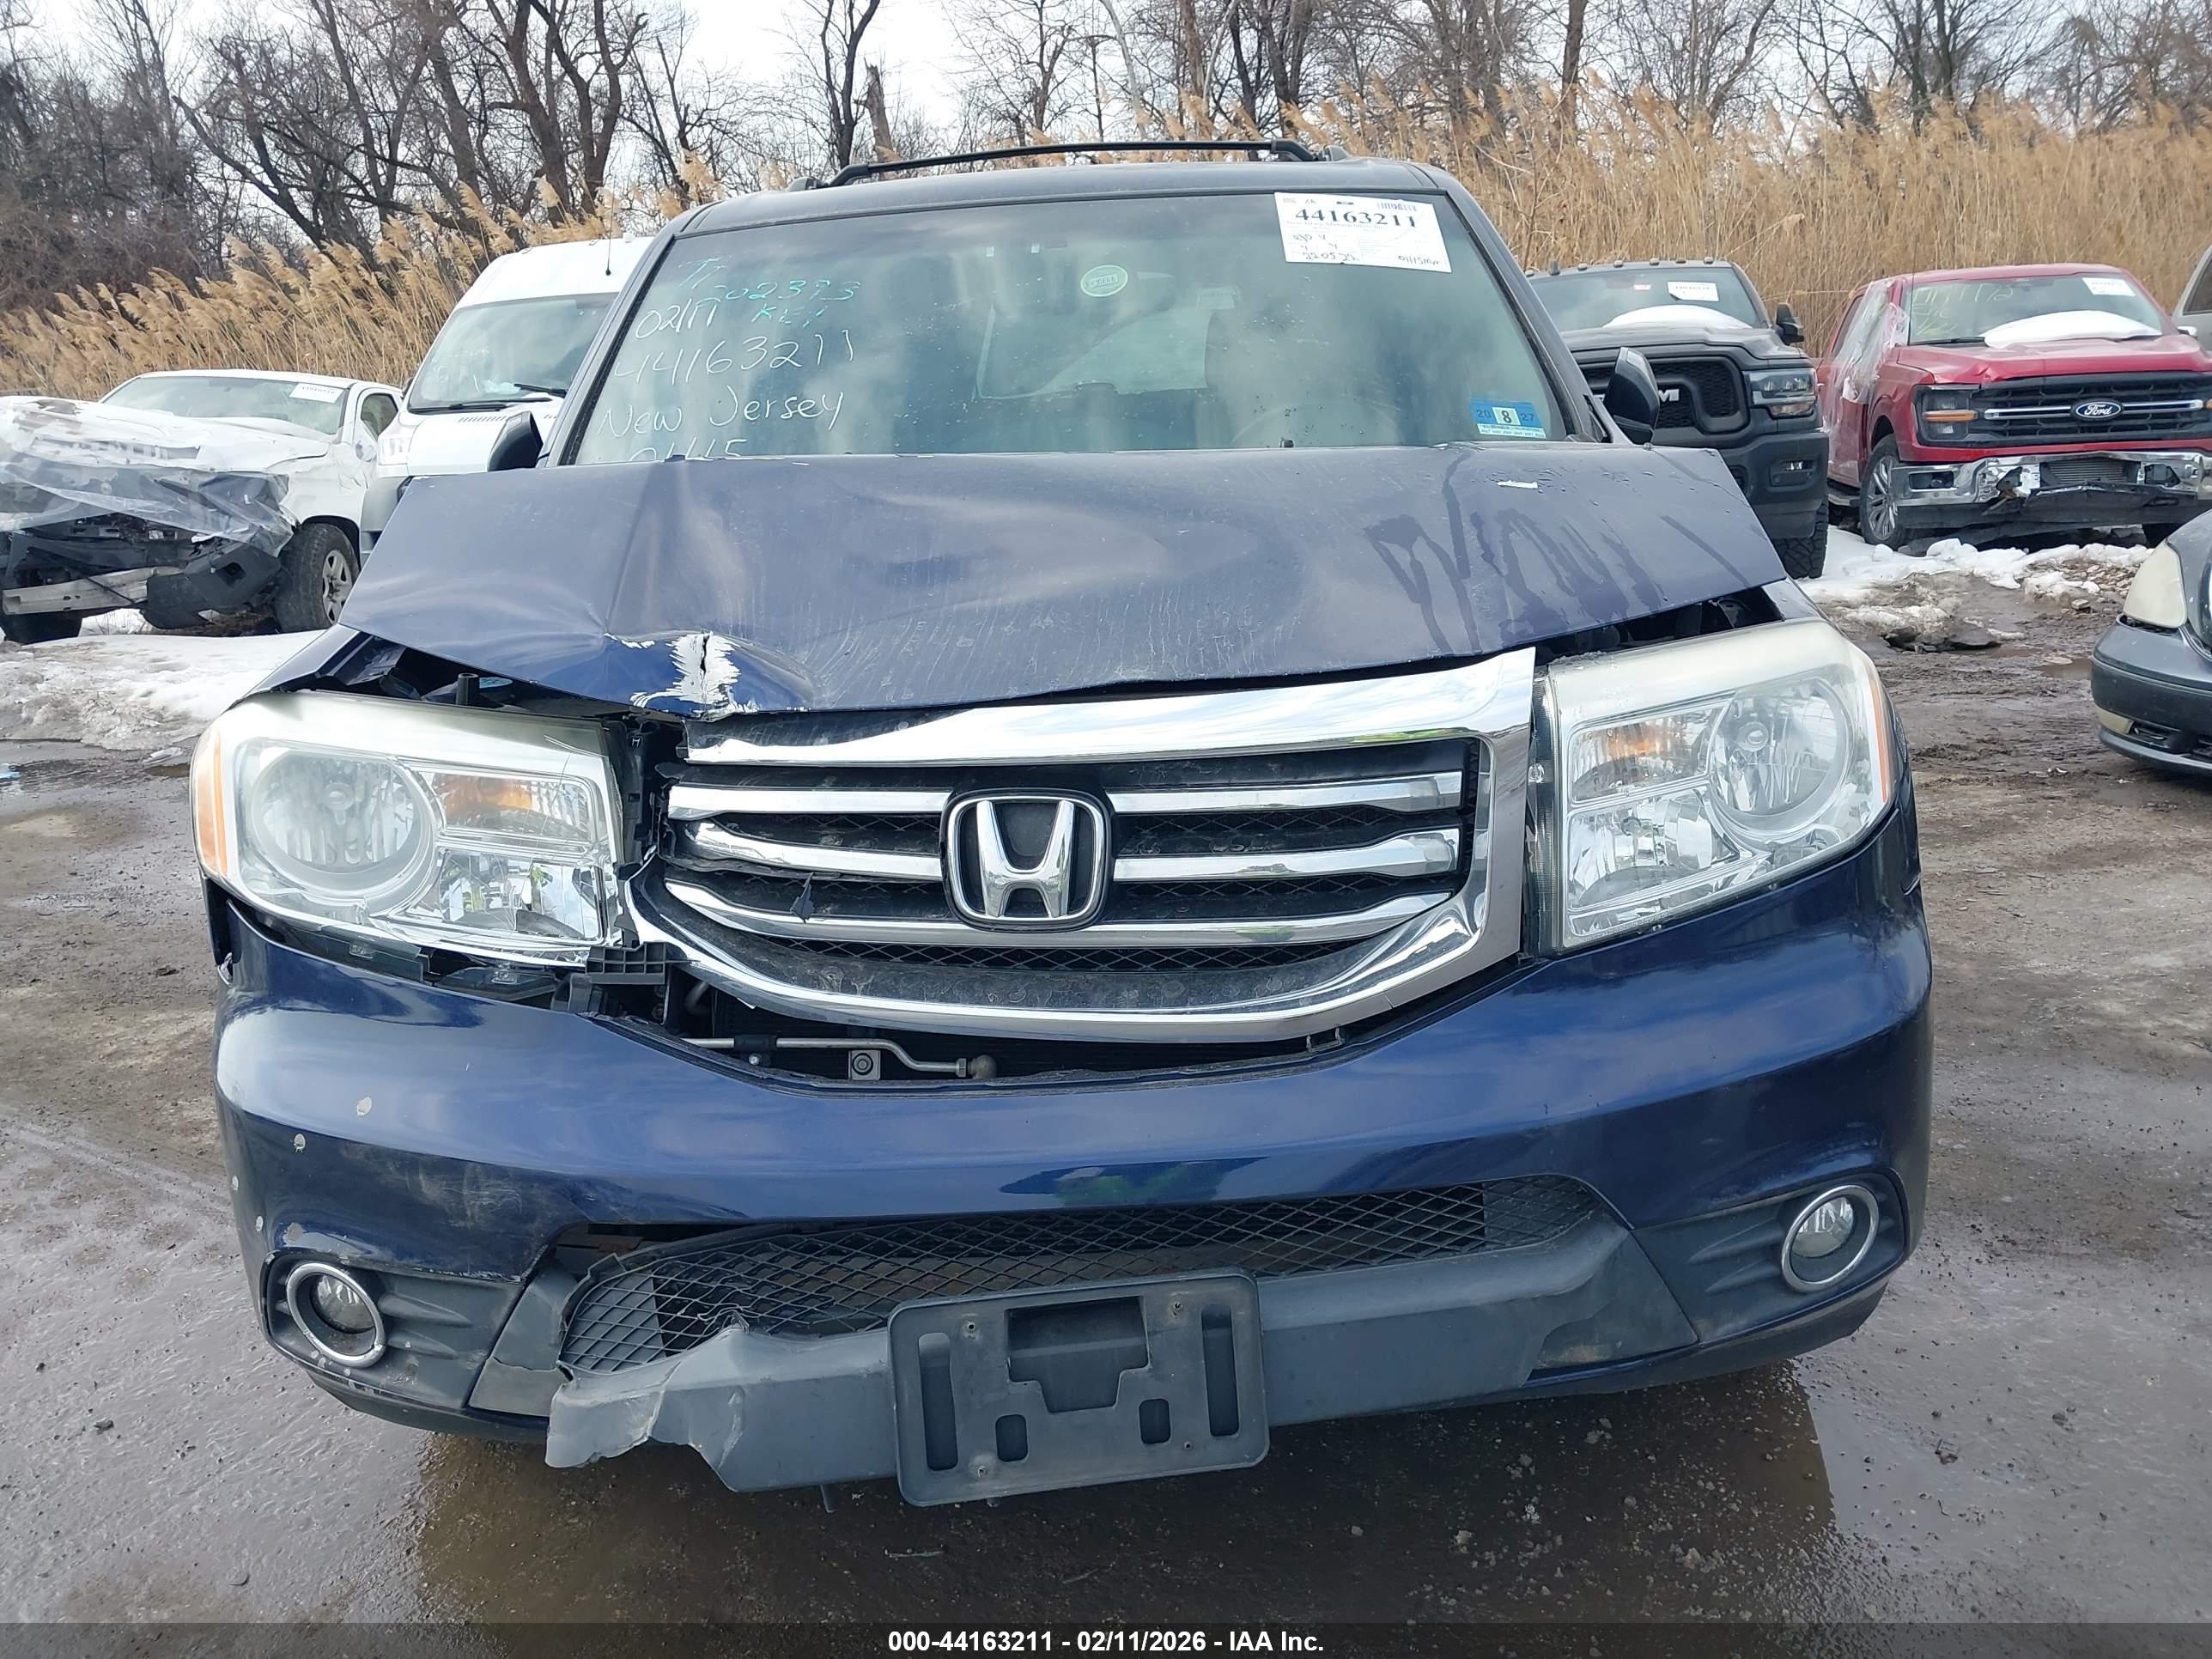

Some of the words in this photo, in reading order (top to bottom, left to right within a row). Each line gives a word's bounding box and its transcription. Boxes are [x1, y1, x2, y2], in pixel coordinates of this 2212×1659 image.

[1295, 209, 1416, 227] 44163211
[613, 329, 854, 386] 44163211
[597, 404, 683, 439] New
[709, 385, 844, 431] Jersey
[1501, 410, 1513, 423] 8
[2083, 404, 2113, 416] Ford
